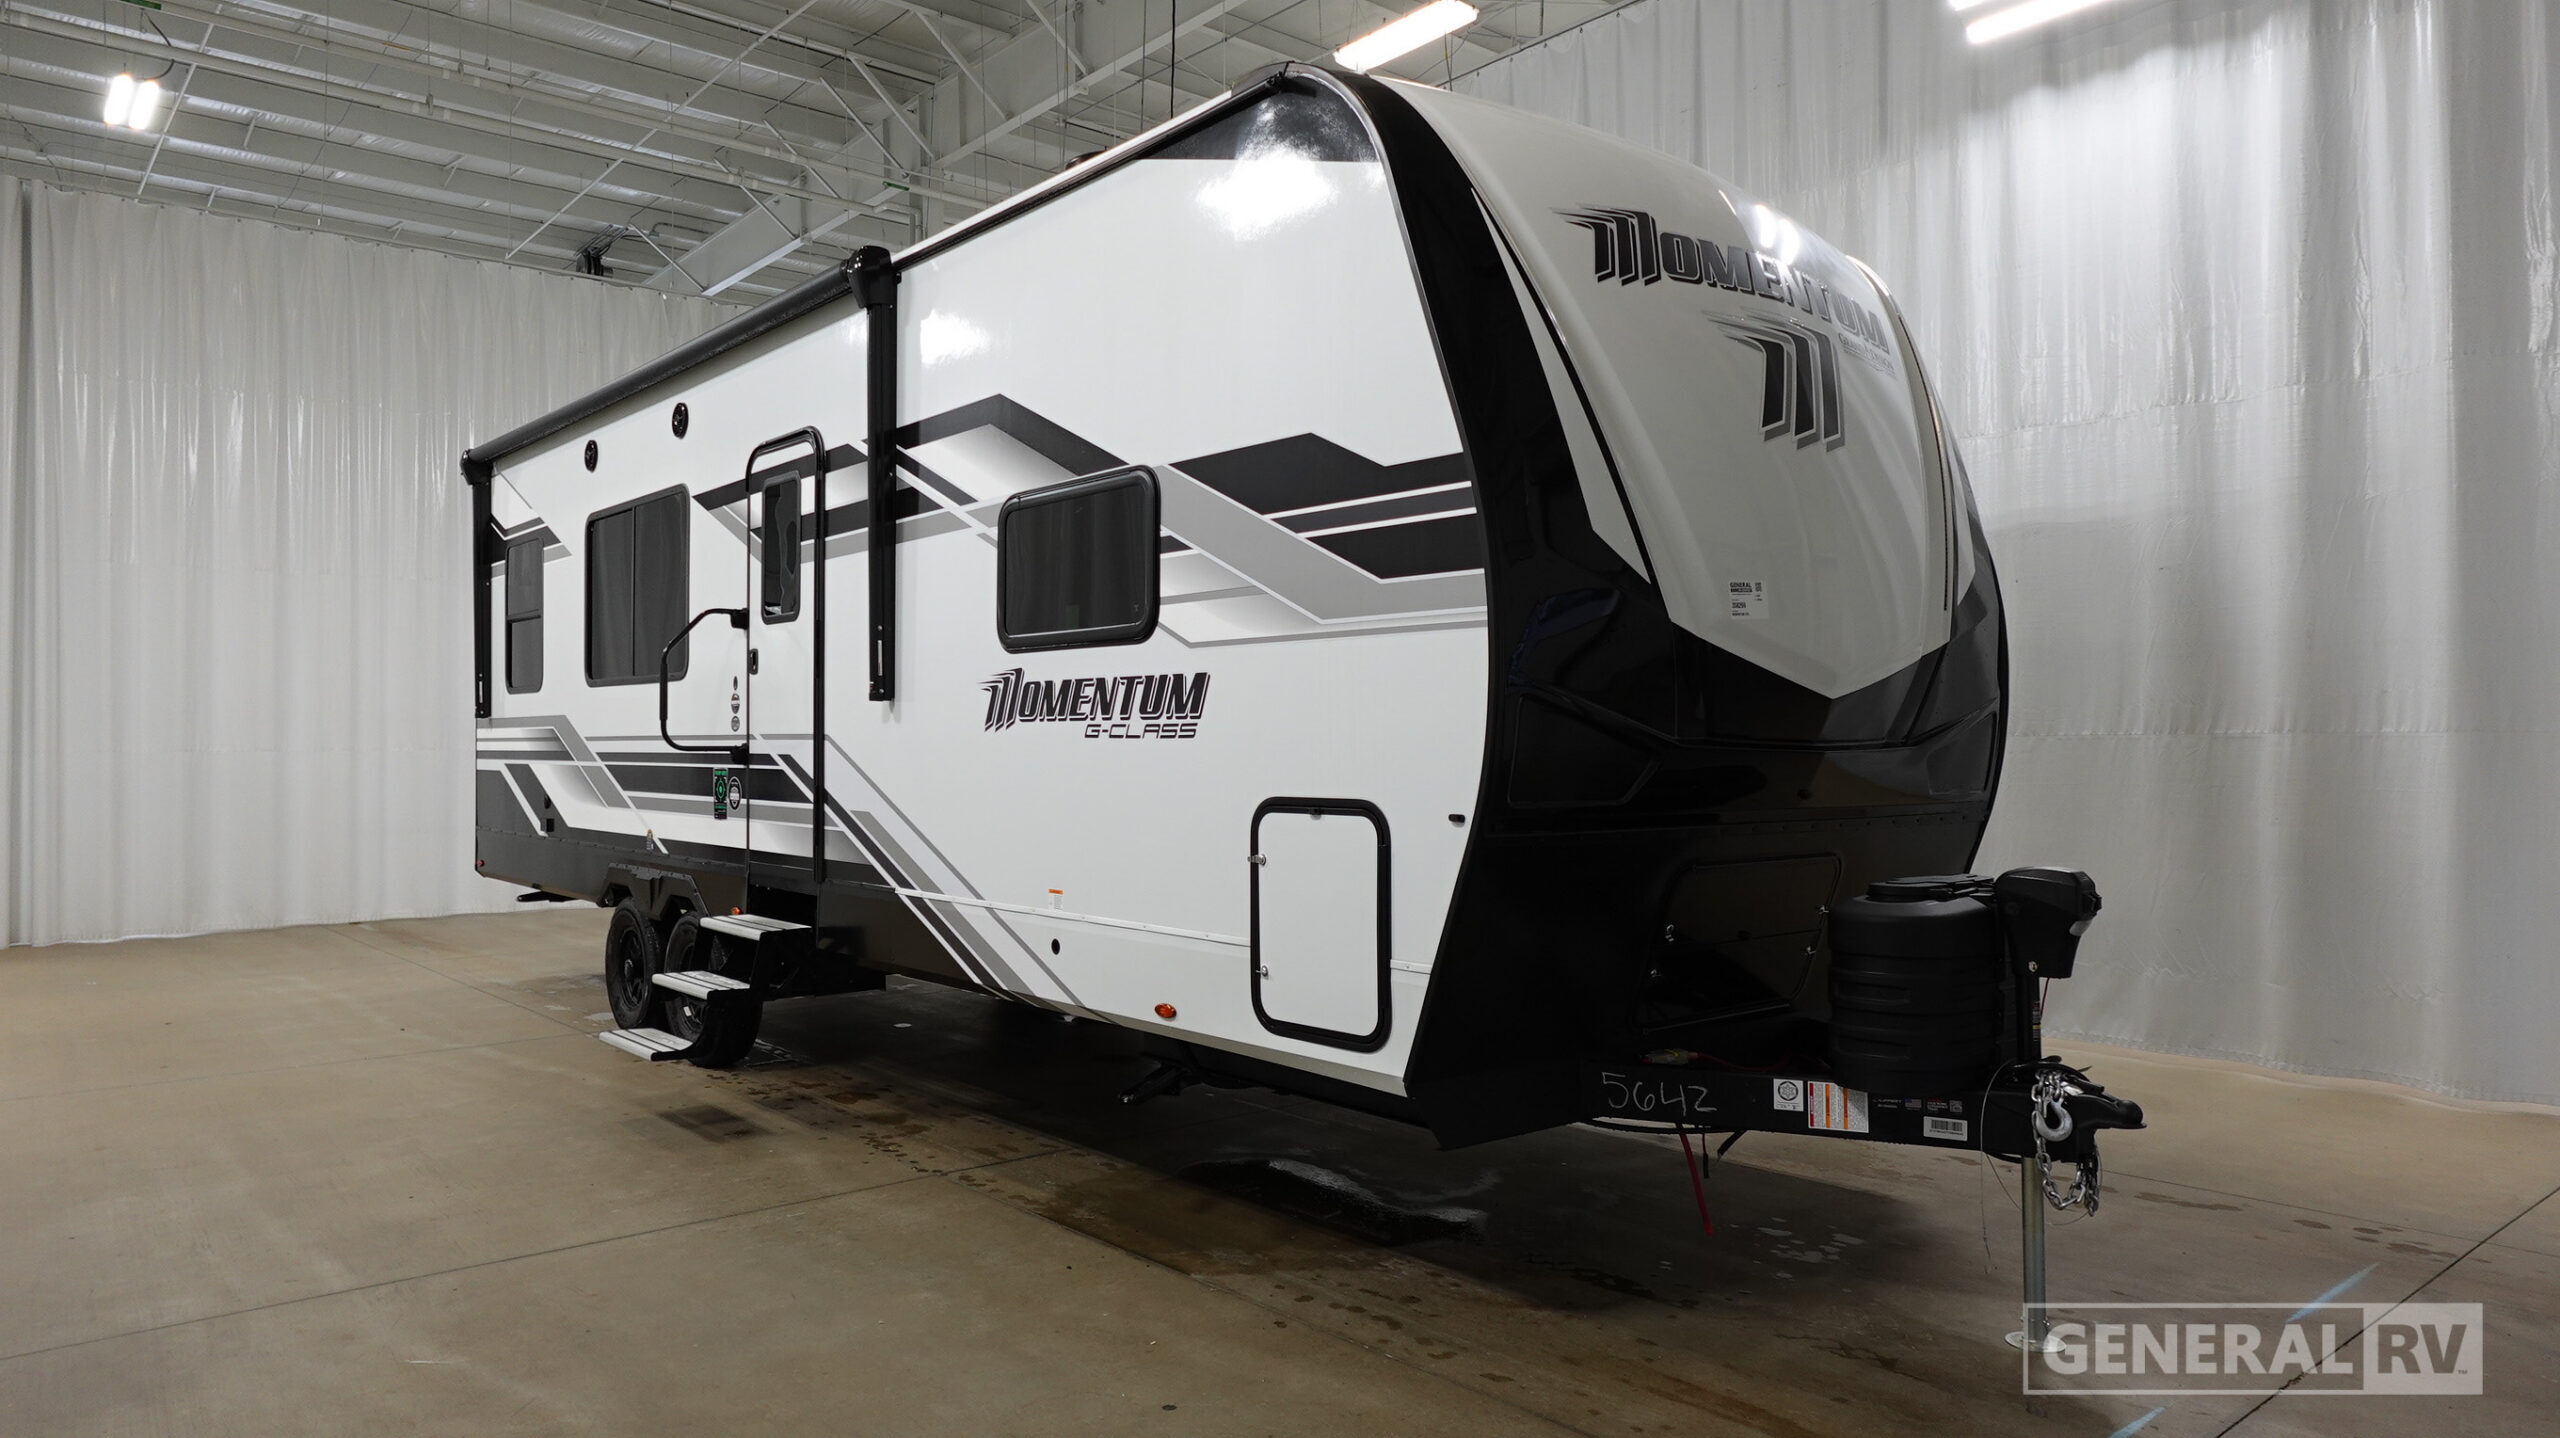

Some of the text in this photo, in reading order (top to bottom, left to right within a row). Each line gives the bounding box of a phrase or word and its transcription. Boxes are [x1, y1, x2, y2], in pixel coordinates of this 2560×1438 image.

[1551, 206, 1891, 355] MOMENTUM
[978, 667, 1211, 733] MOMENTUM
[1084, 723, 1198, 739] G-CLASS
[1601, 1071, 1718, 1117] 5642
